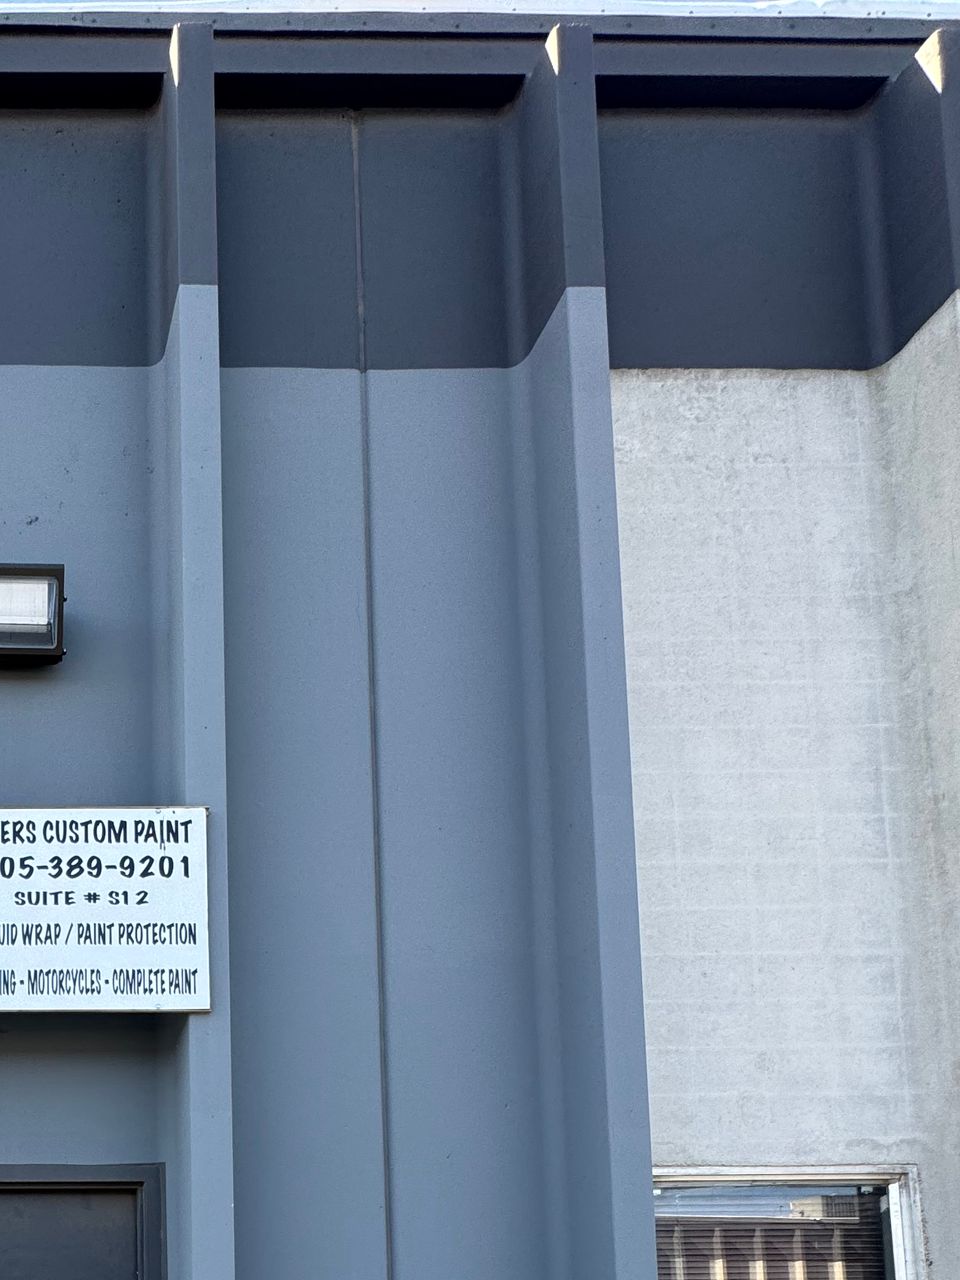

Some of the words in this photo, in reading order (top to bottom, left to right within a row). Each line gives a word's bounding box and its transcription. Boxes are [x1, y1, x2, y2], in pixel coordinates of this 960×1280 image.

[42, 819, 128, 845] CUSTOM
[134, 819, 194, 846] PAINT
[14, 890, 76, 906] SUITE
[83, 890, 101, 906] #
[108, 890, 149, 906] S12
[21, 922, 61, 946] WRAP
[65, 922, 74, 946] /
[77, 922, 116, 946] PAINT
[118, 922, 198, 946] PROTECTION
[27, 968, 102, 996] MOTORCYCLES
[112, 968, 166, 996] COMPLETE
[168, 968, 198, 996] PAINT
